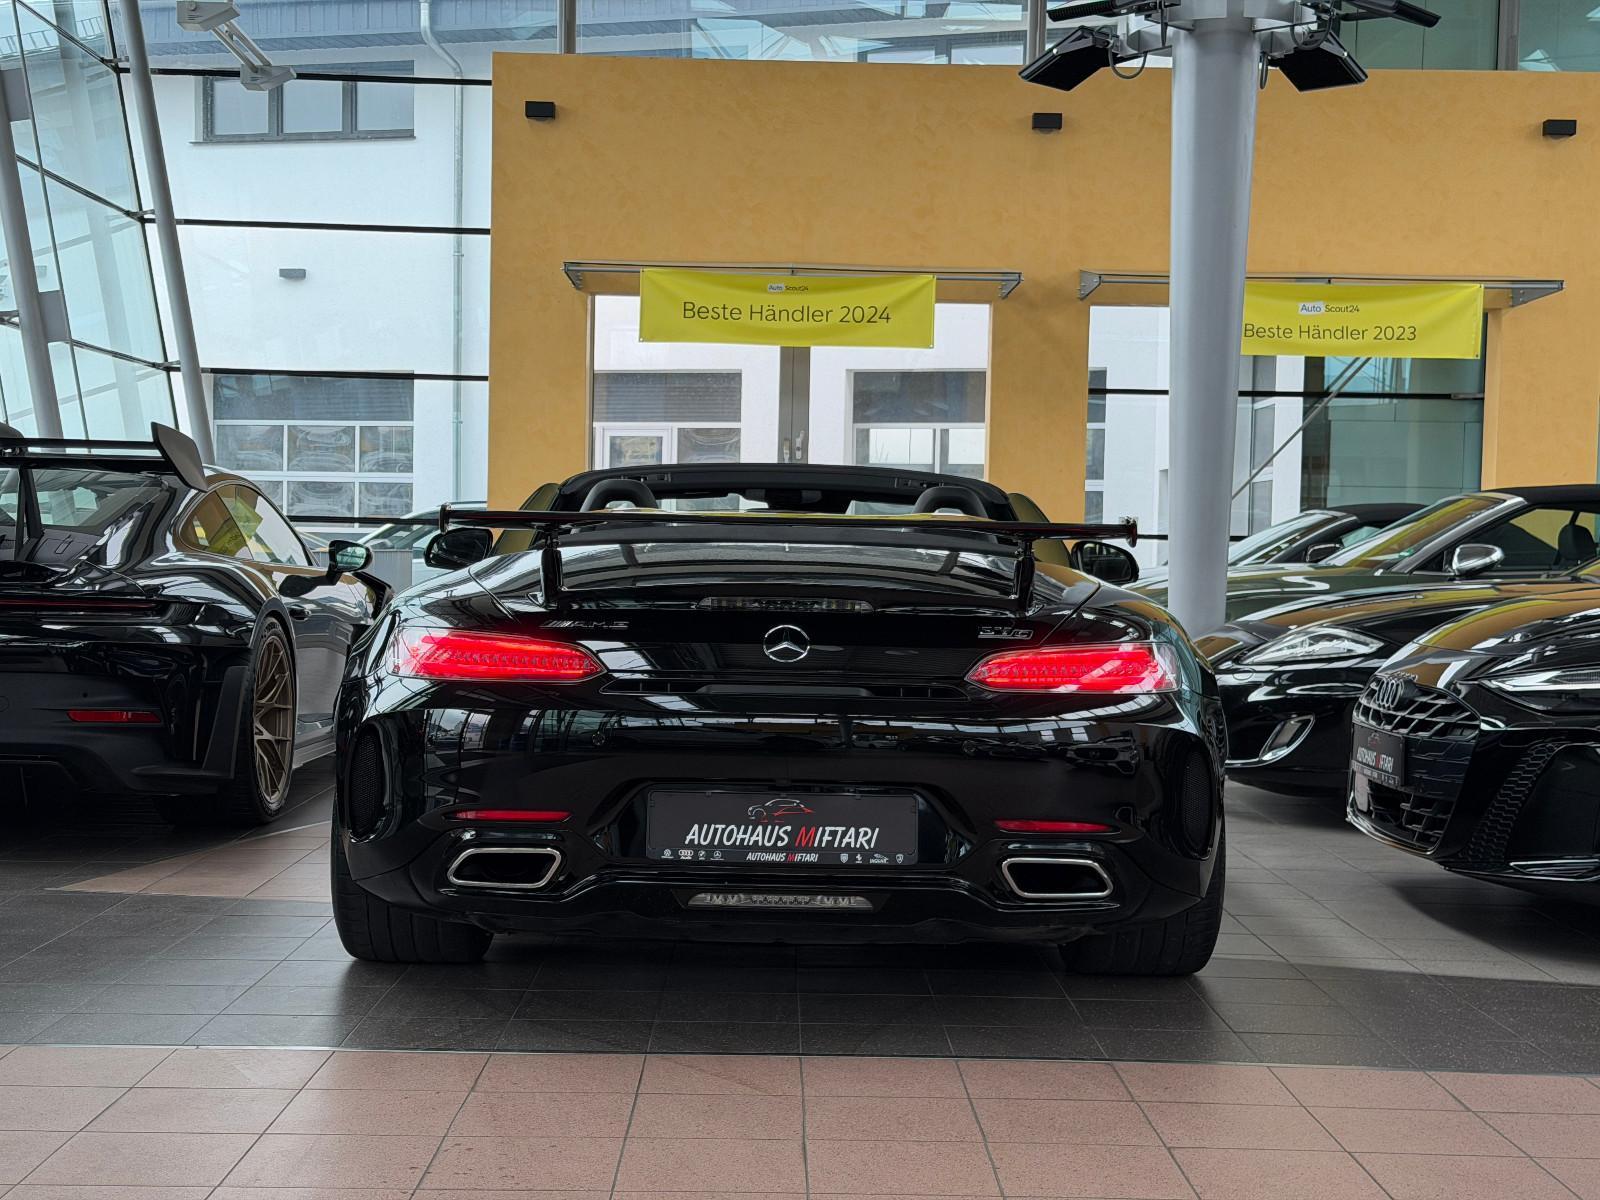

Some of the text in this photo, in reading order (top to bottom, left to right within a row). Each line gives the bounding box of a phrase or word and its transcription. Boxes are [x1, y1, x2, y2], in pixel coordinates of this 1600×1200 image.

[683, 301, 892, 323] Beste Händler 2024
[1300, 304, 1360, 313] Auto Scout24
[1244, 323, 1417, 341] Beste Händler 2023
[685, 824, 880, 849] AUTOHAUS MIFTARI
[746, 852, 819, 862] AUTOHAUS MIFTARI
